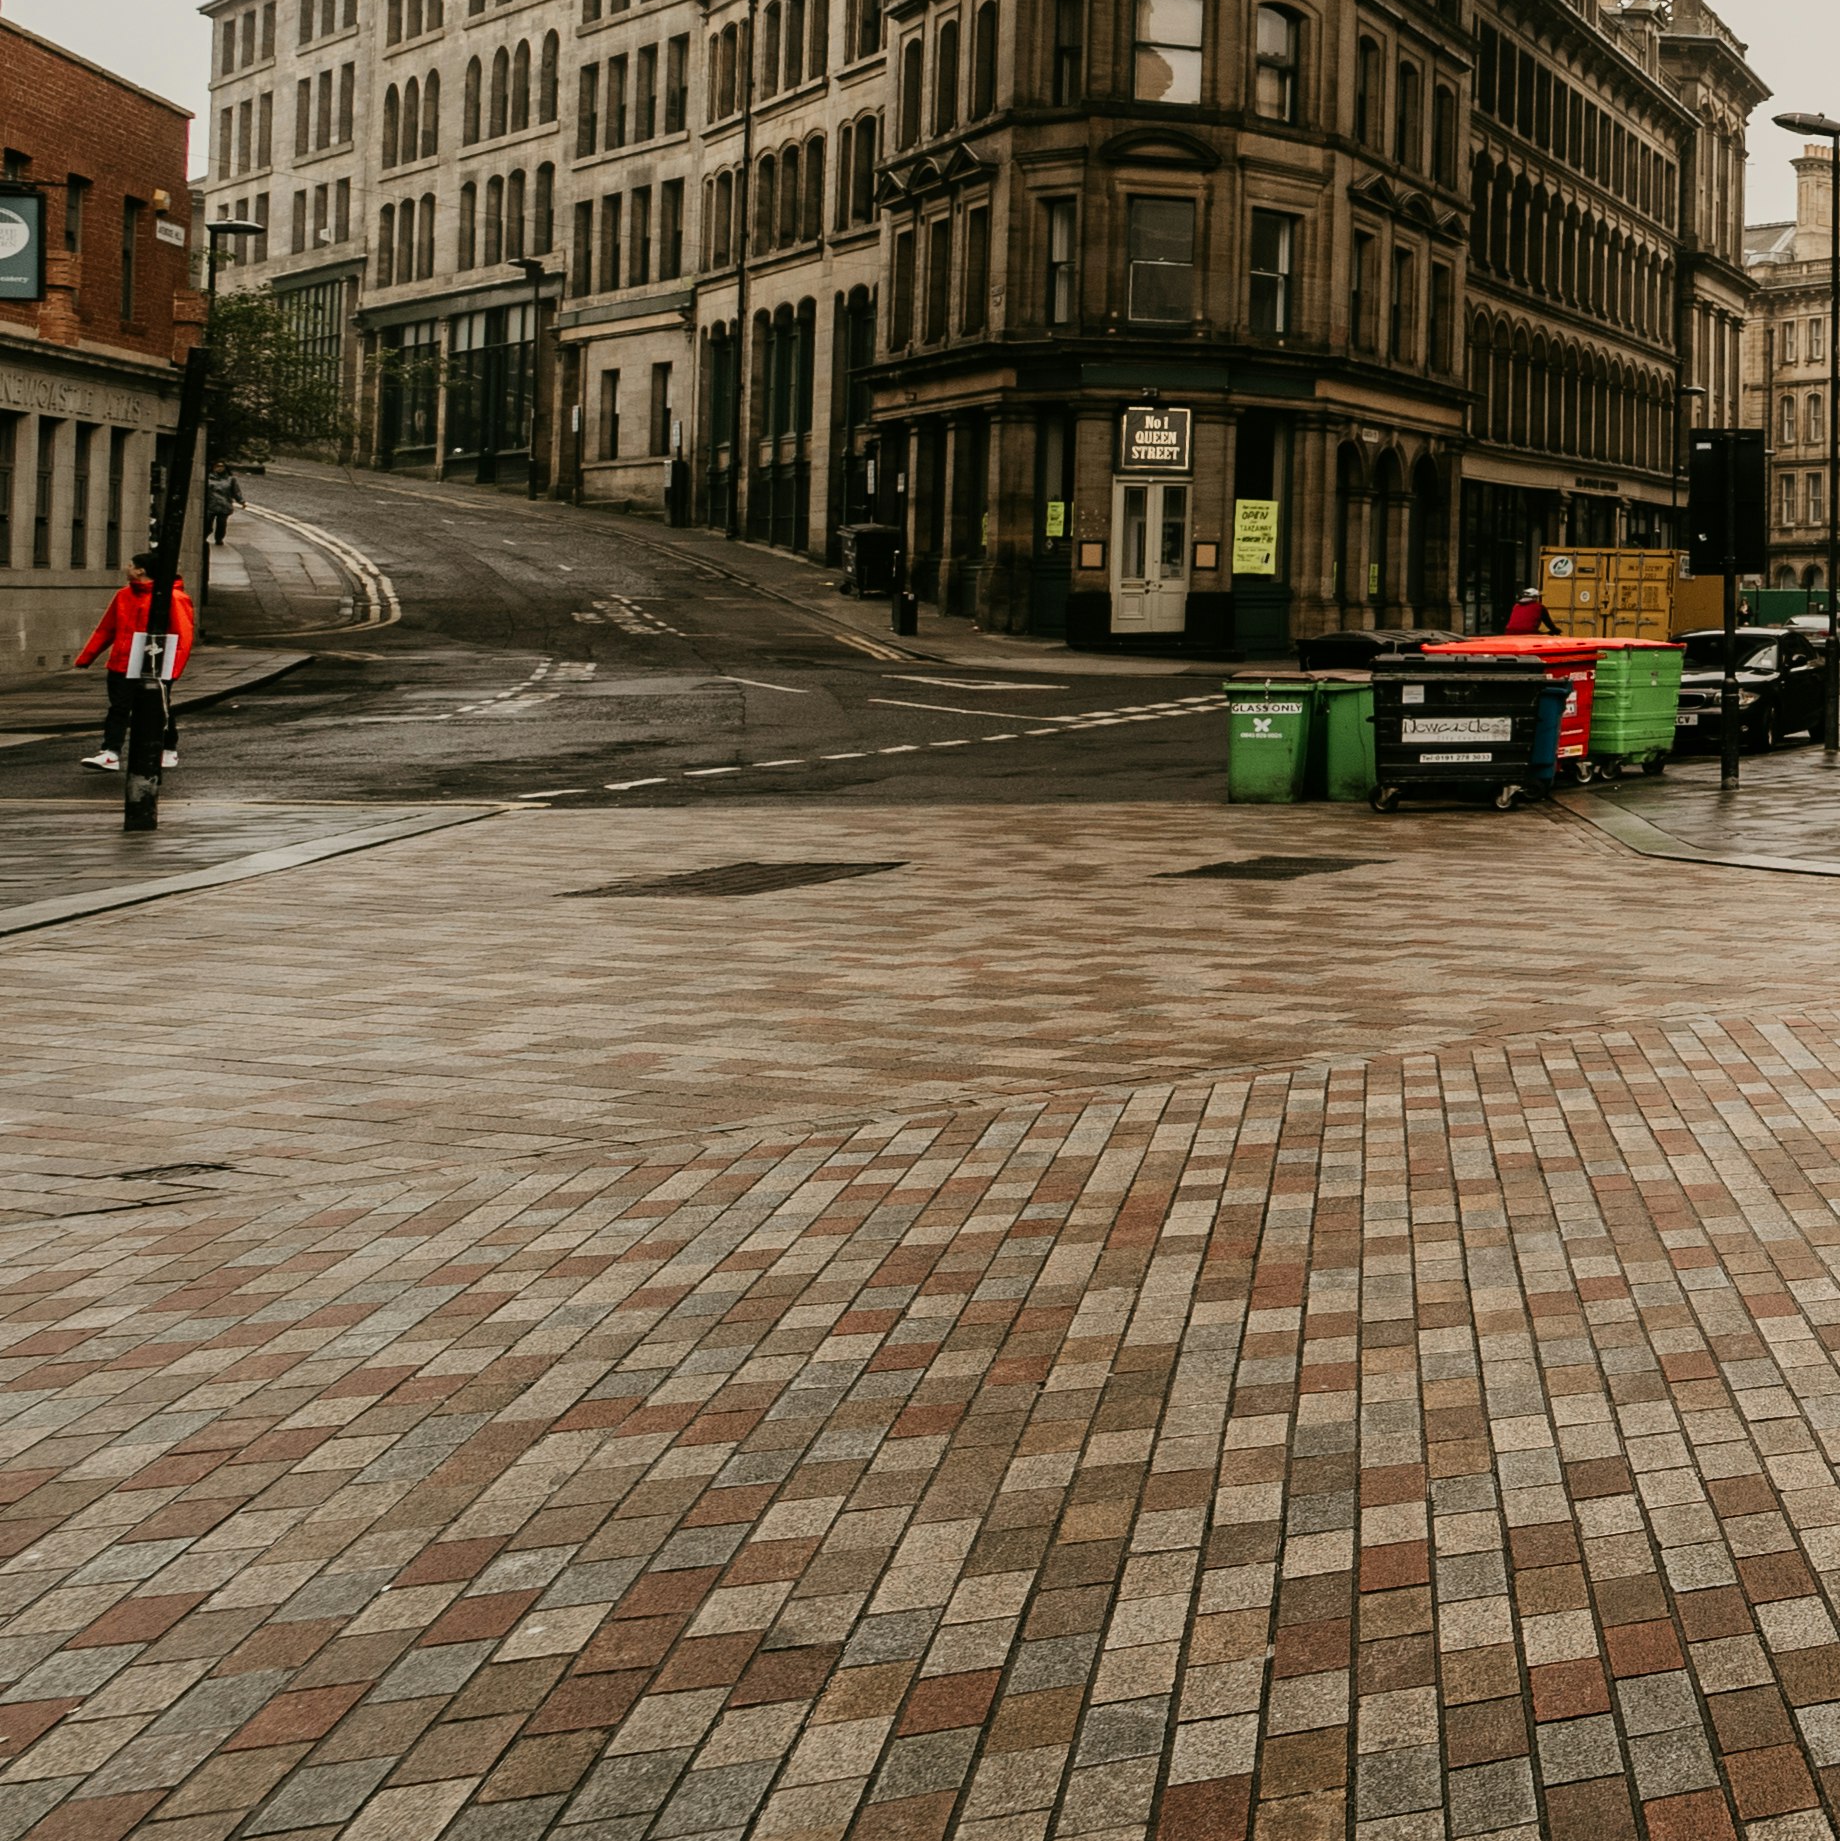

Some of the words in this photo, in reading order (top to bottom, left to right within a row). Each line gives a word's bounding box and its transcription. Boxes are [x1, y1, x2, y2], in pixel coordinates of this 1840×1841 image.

[1144, 415, 1161, 429] No
[1163, 416, 1169, 429] 1
[1135, 431, 1177, 445] QUEEN
[1131, 446, 1180, 460] STREET
[1242, 511, 1268, 520] OPEN
[1232, 704, 1269, 712] GLASS
[1404, 718, 1490, 734] Newcastle
[1472, 753, 1490, 761] 3033
